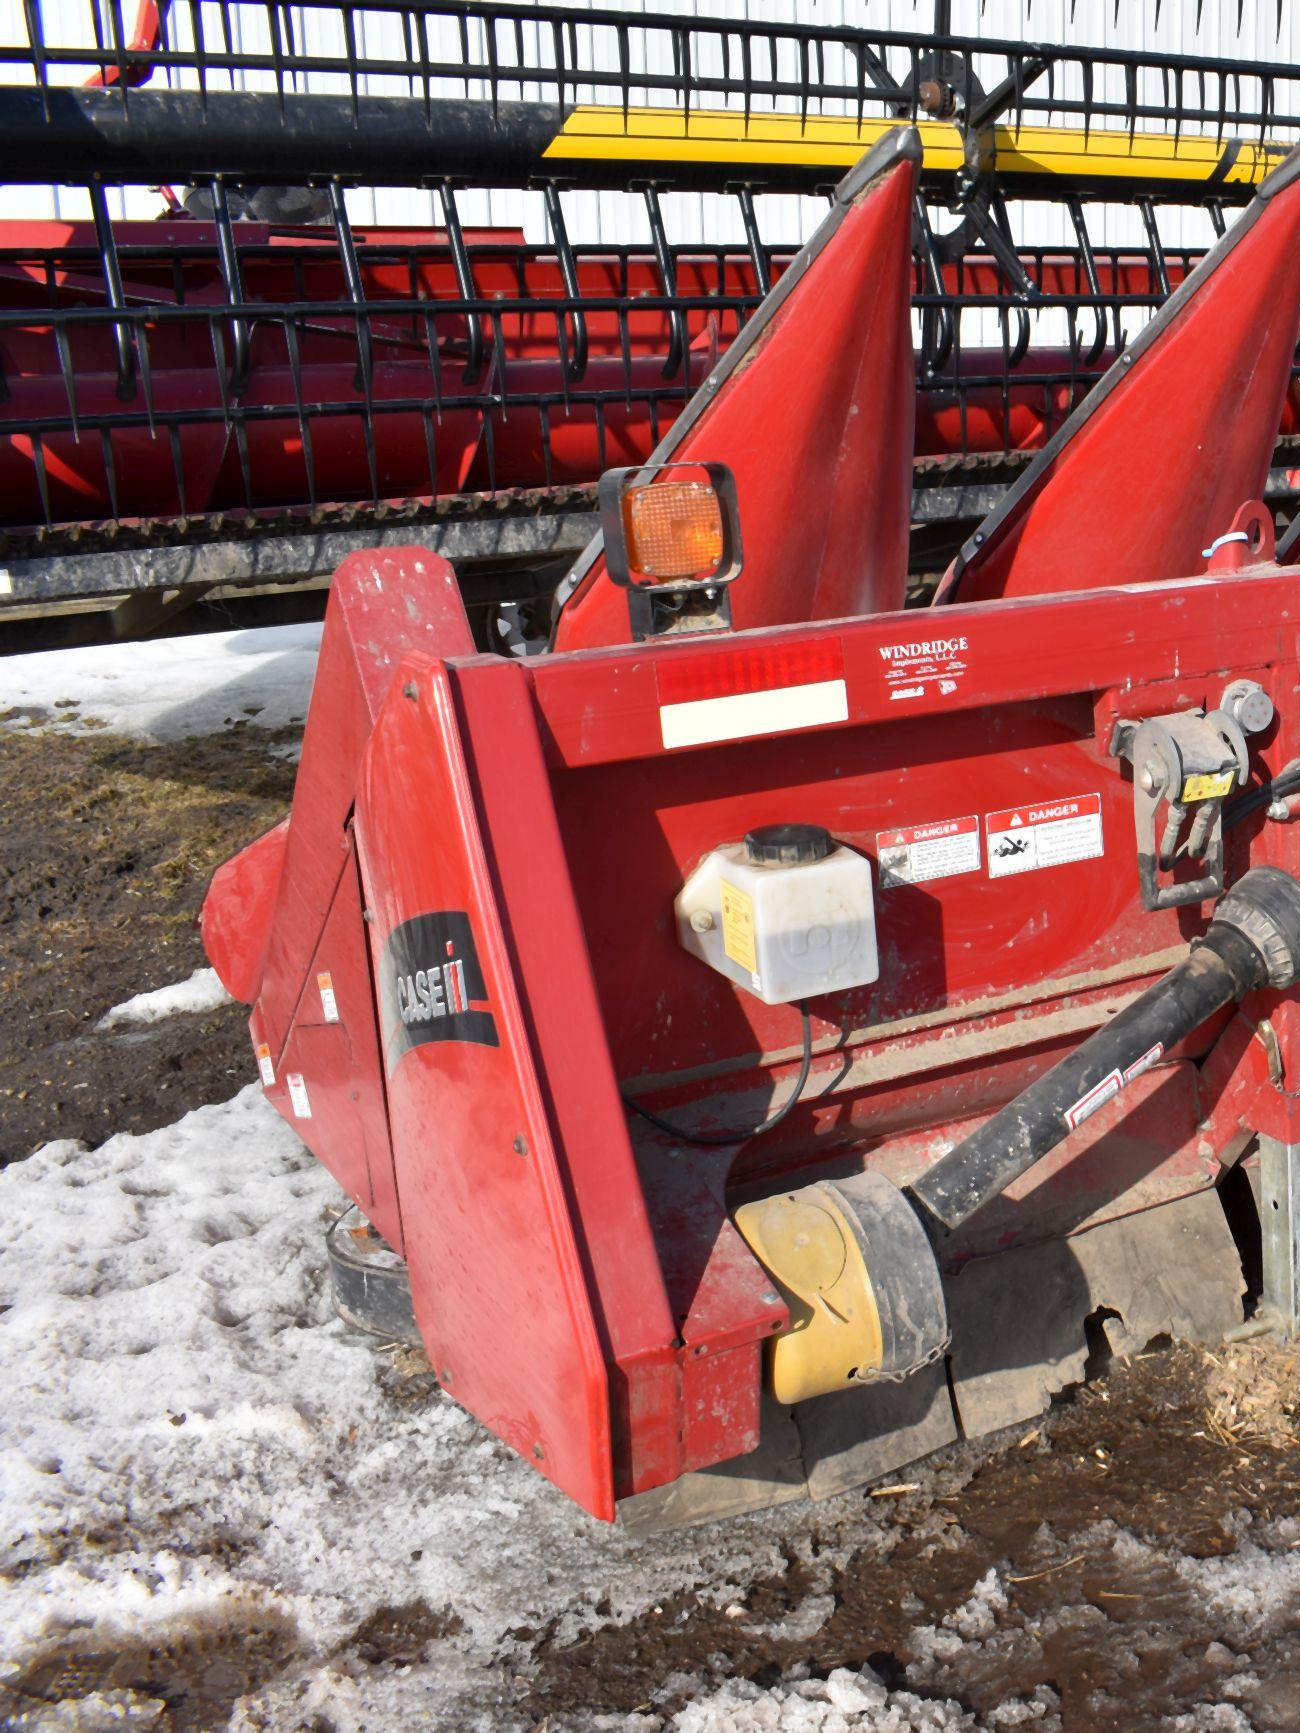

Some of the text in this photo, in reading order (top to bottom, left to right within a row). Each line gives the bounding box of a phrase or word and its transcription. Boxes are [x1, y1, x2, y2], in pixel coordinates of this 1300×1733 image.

[879, 637, 968, 660] WINDRIDGE
[1029, 803, 1079, 823] DANGER
[913, 823, 958, 840] DANGER
